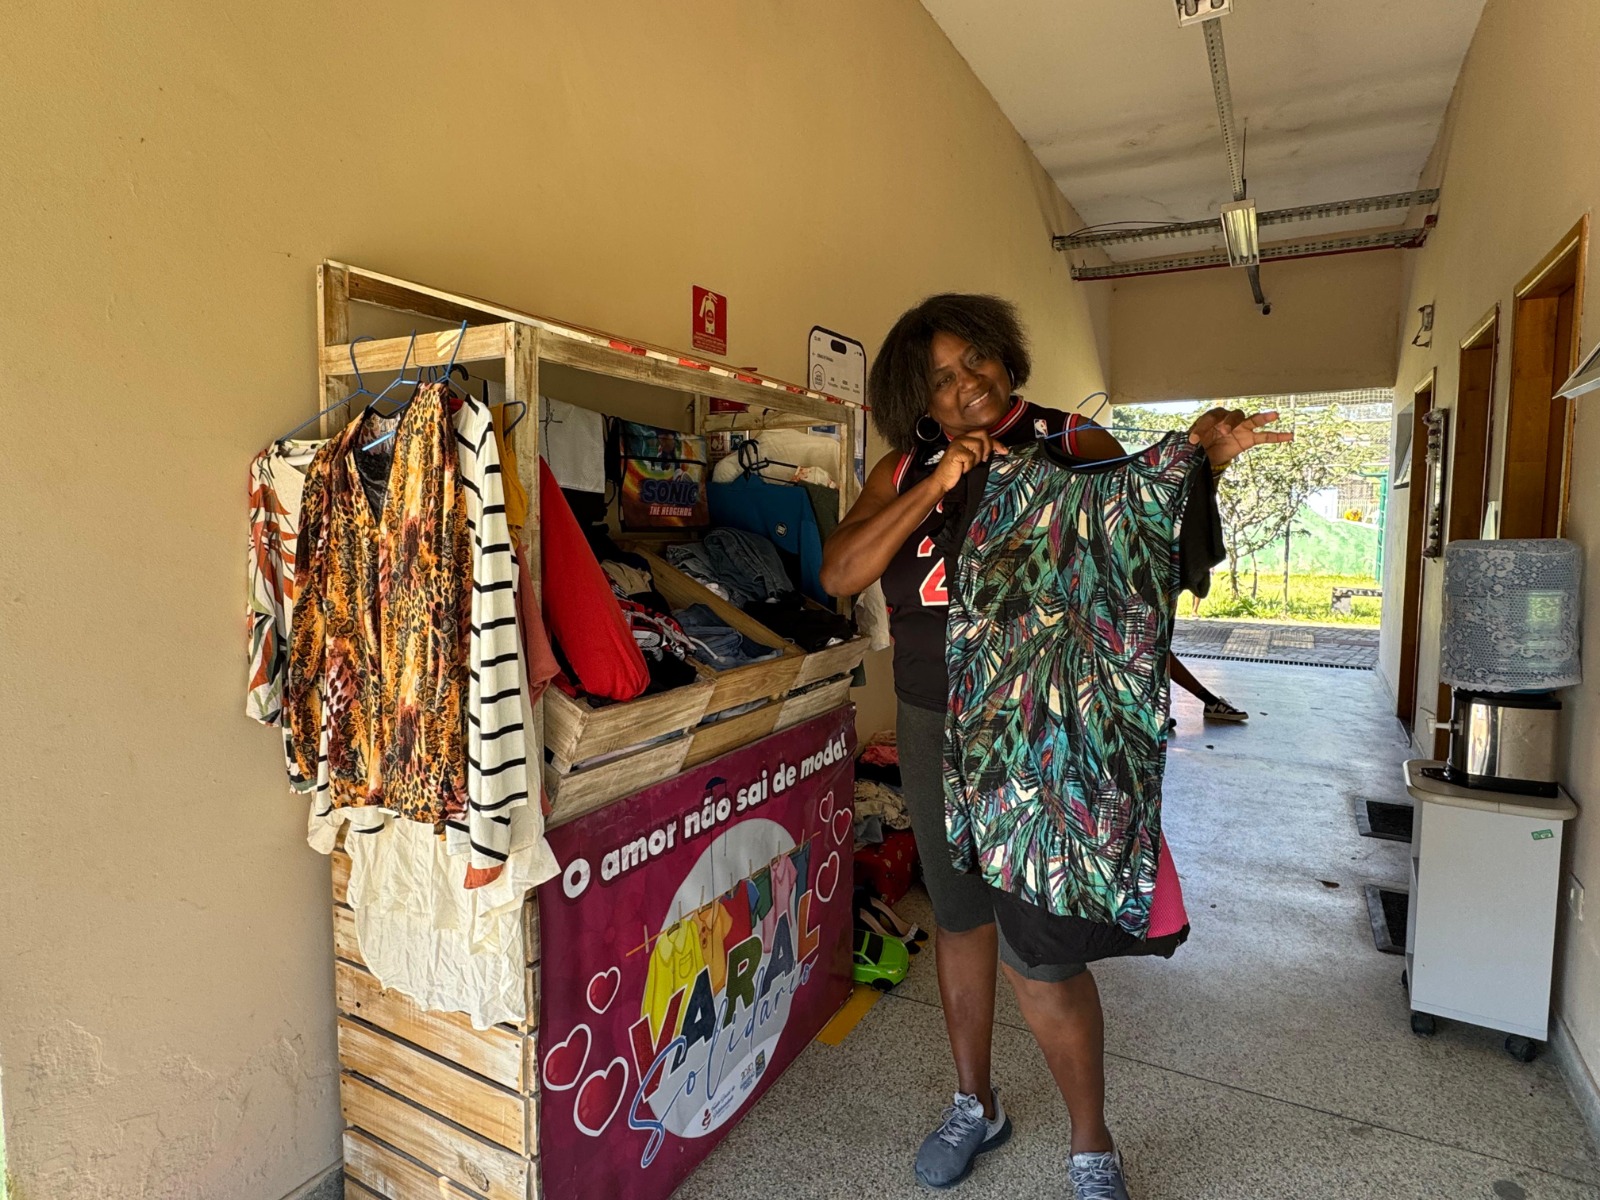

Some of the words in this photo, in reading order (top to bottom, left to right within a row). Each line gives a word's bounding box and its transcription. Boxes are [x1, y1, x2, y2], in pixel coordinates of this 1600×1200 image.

[641, 478, 699, 505] SONIC
[649, 506, 660, 516] THE
[563, 858, 591, 899] O
[601, 820, 677, 881] amor
[684, 794, 731, 838] não
[736, 770, 768, 812] sai
[773, 763, 796, 794] de
[800, 732, 848, 780] moda!
[628, 889, 821, 1103] VARAL
